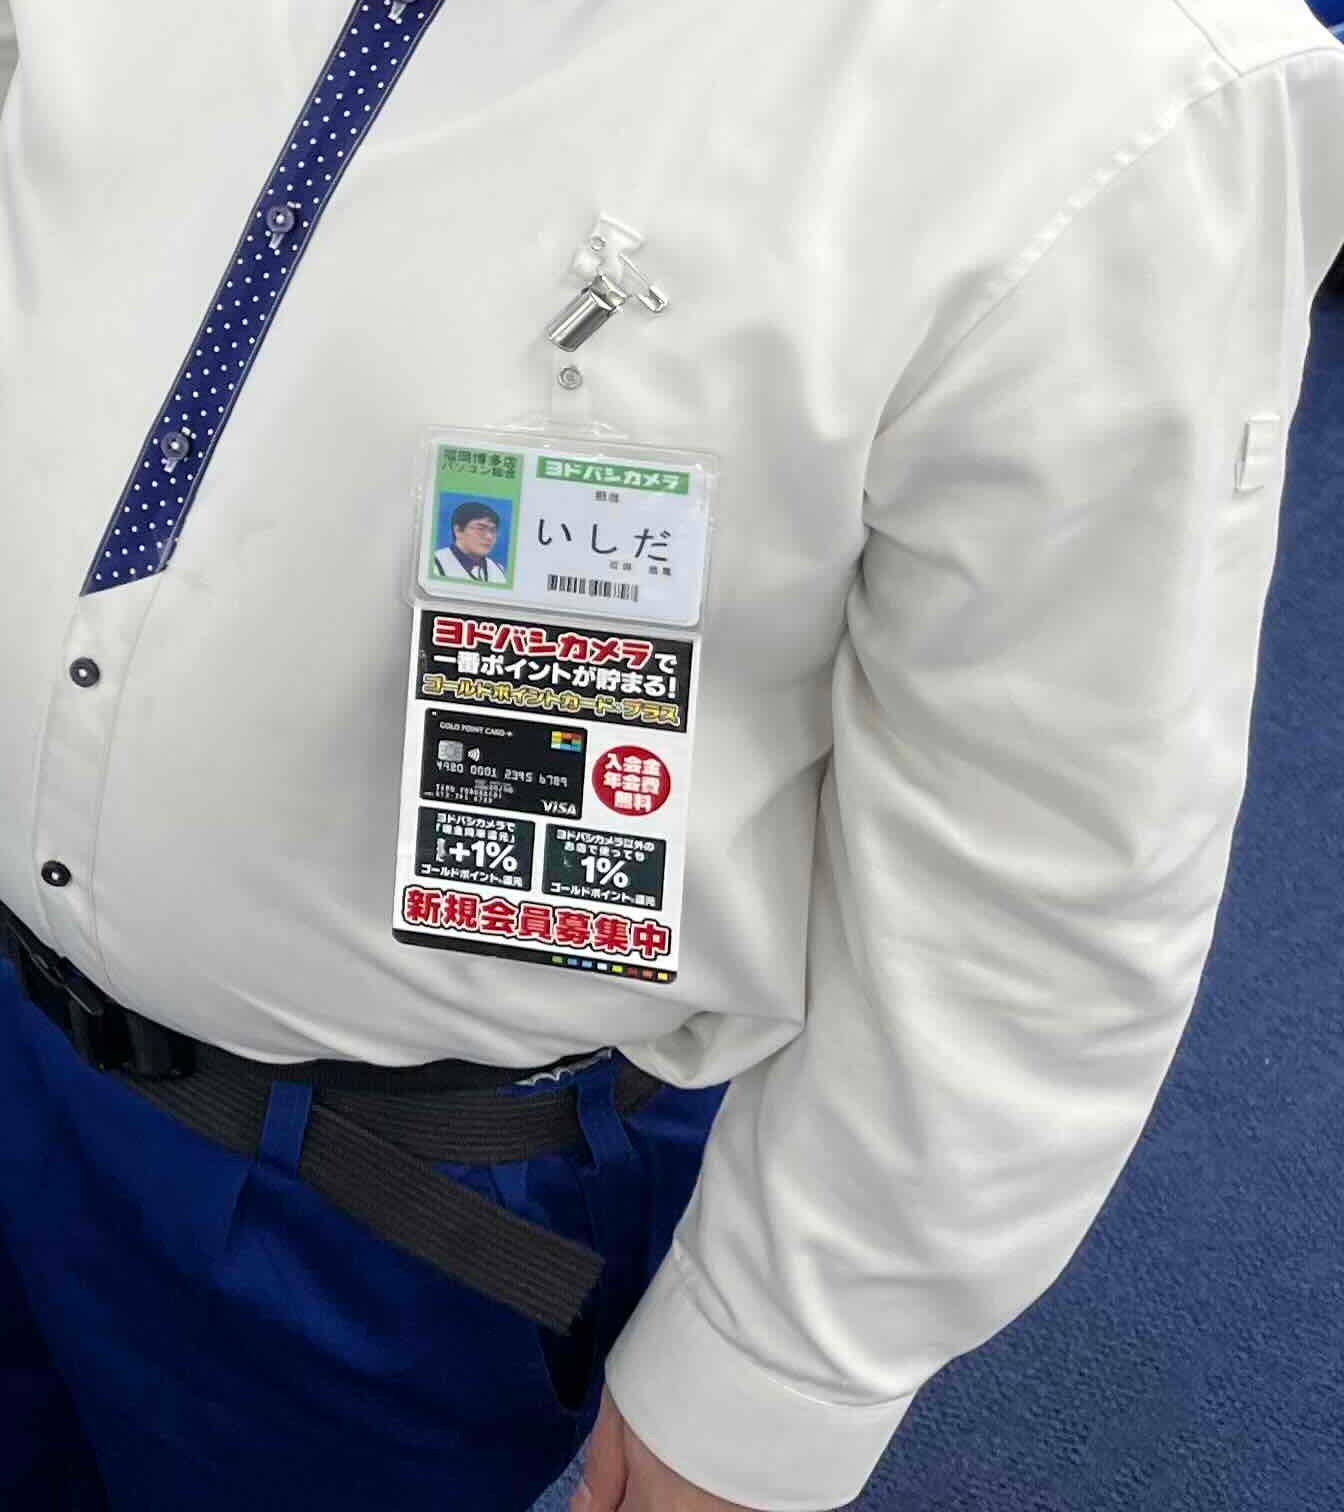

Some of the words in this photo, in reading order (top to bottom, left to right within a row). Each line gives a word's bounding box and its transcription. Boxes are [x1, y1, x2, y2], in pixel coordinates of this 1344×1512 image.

[544, 460, 681, 490] ヨドバシカメラ
[537, 517, 672, 563] いしだ
[432, 616, 678, 670] ヨドバシカメラで
[433, 651, 678, 700] 一番ポイントが貯まる!
[542, 800, 577, 815] VISA
[581, 856, 628, 888] 1%
[402, 885, 671, 960] 新規会員募集中
